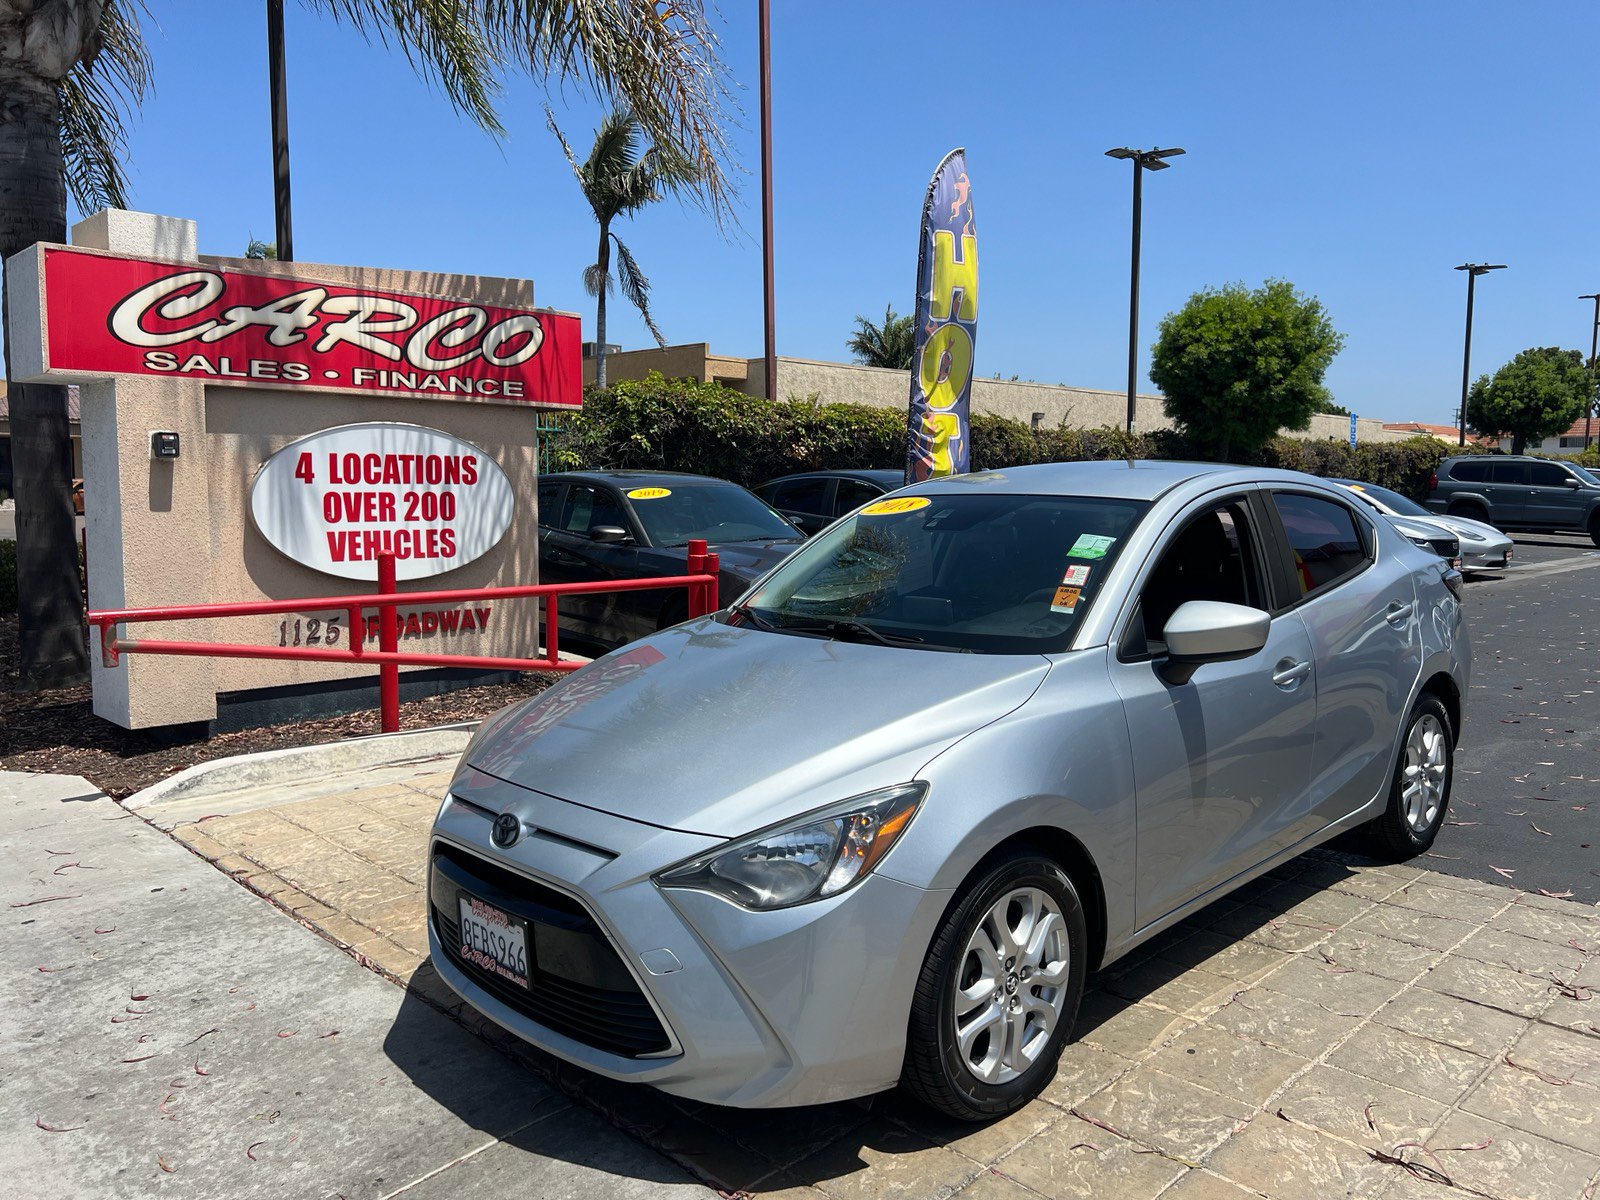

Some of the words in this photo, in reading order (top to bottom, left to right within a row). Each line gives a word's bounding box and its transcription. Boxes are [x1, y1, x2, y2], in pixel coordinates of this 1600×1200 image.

[107, 270, 545, 371] CARCO
[920, 229, 979, 478] HOT
[143, 350, 311, 381] SALES
[352, 367, 526, 397] FINANCE
[295, 452, 315, 484] 4
[329, 452, 478, 485] LOCATIONS
[323, 491, 396, 523] OVER
[403, 491, 456, 522] 200
[637, 489, 664, 498] 2019
[326, 528, 457, 562] VEHICLES
[279, 616, 340, 647] 1125
